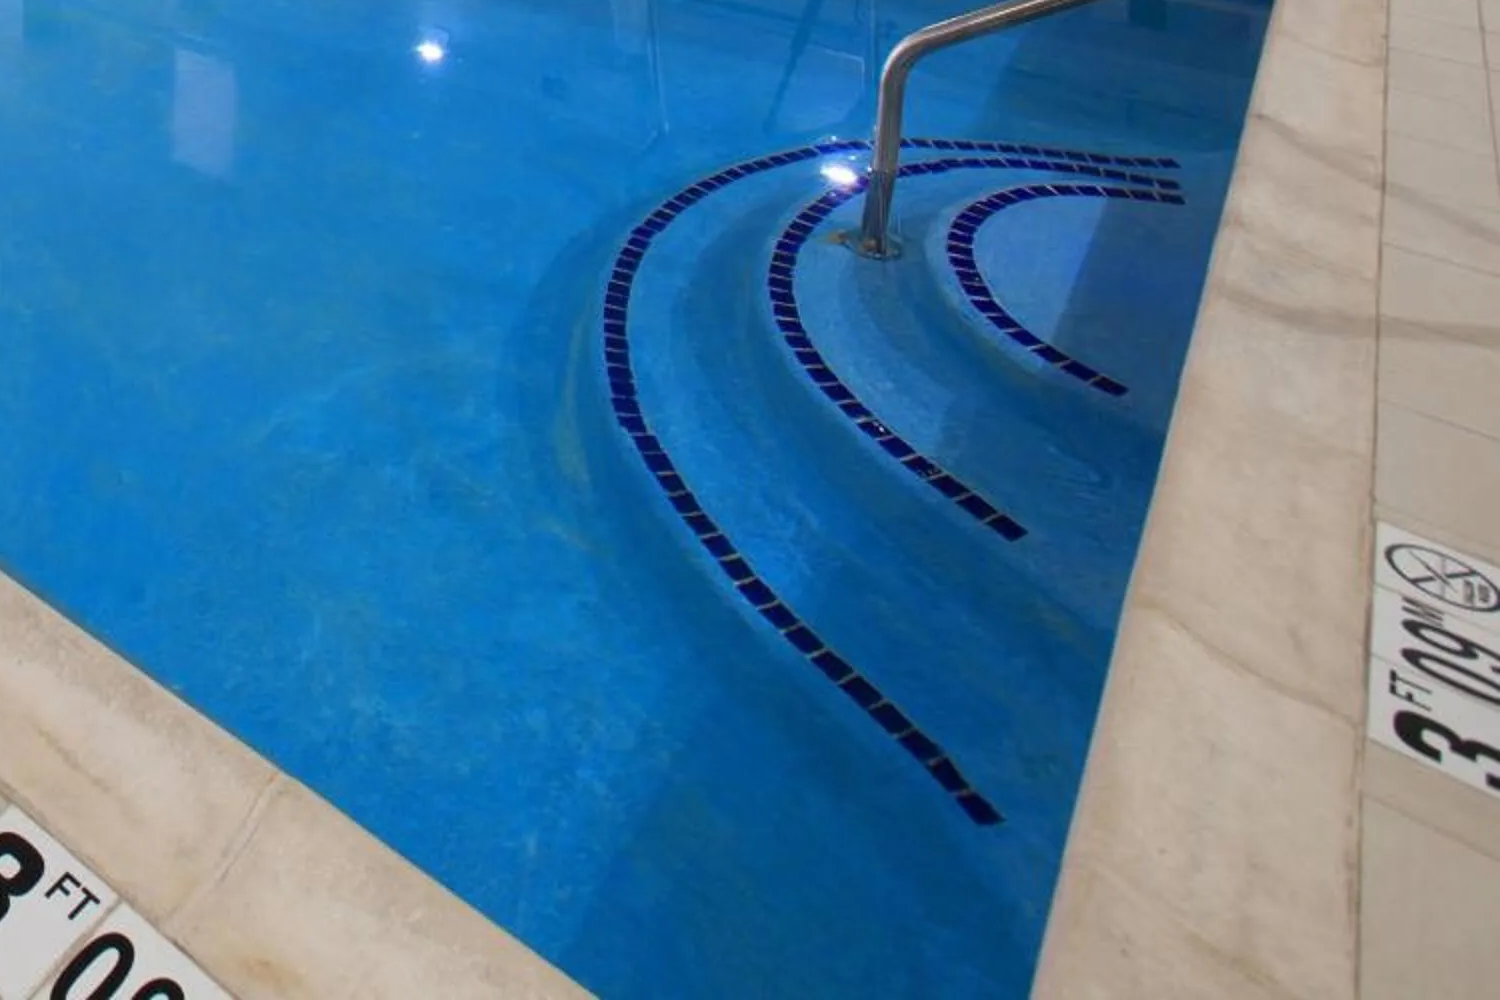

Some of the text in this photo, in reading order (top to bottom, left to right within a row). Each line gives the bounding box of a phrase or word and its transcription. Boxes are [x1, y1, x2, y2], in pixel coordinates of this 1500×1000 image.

[1389, 669, 1433, 712] FT
[1393, 710, 1500, 791] 3
[45, 871, 101, 920] FT
[50, 931, 185, 1000] 0
